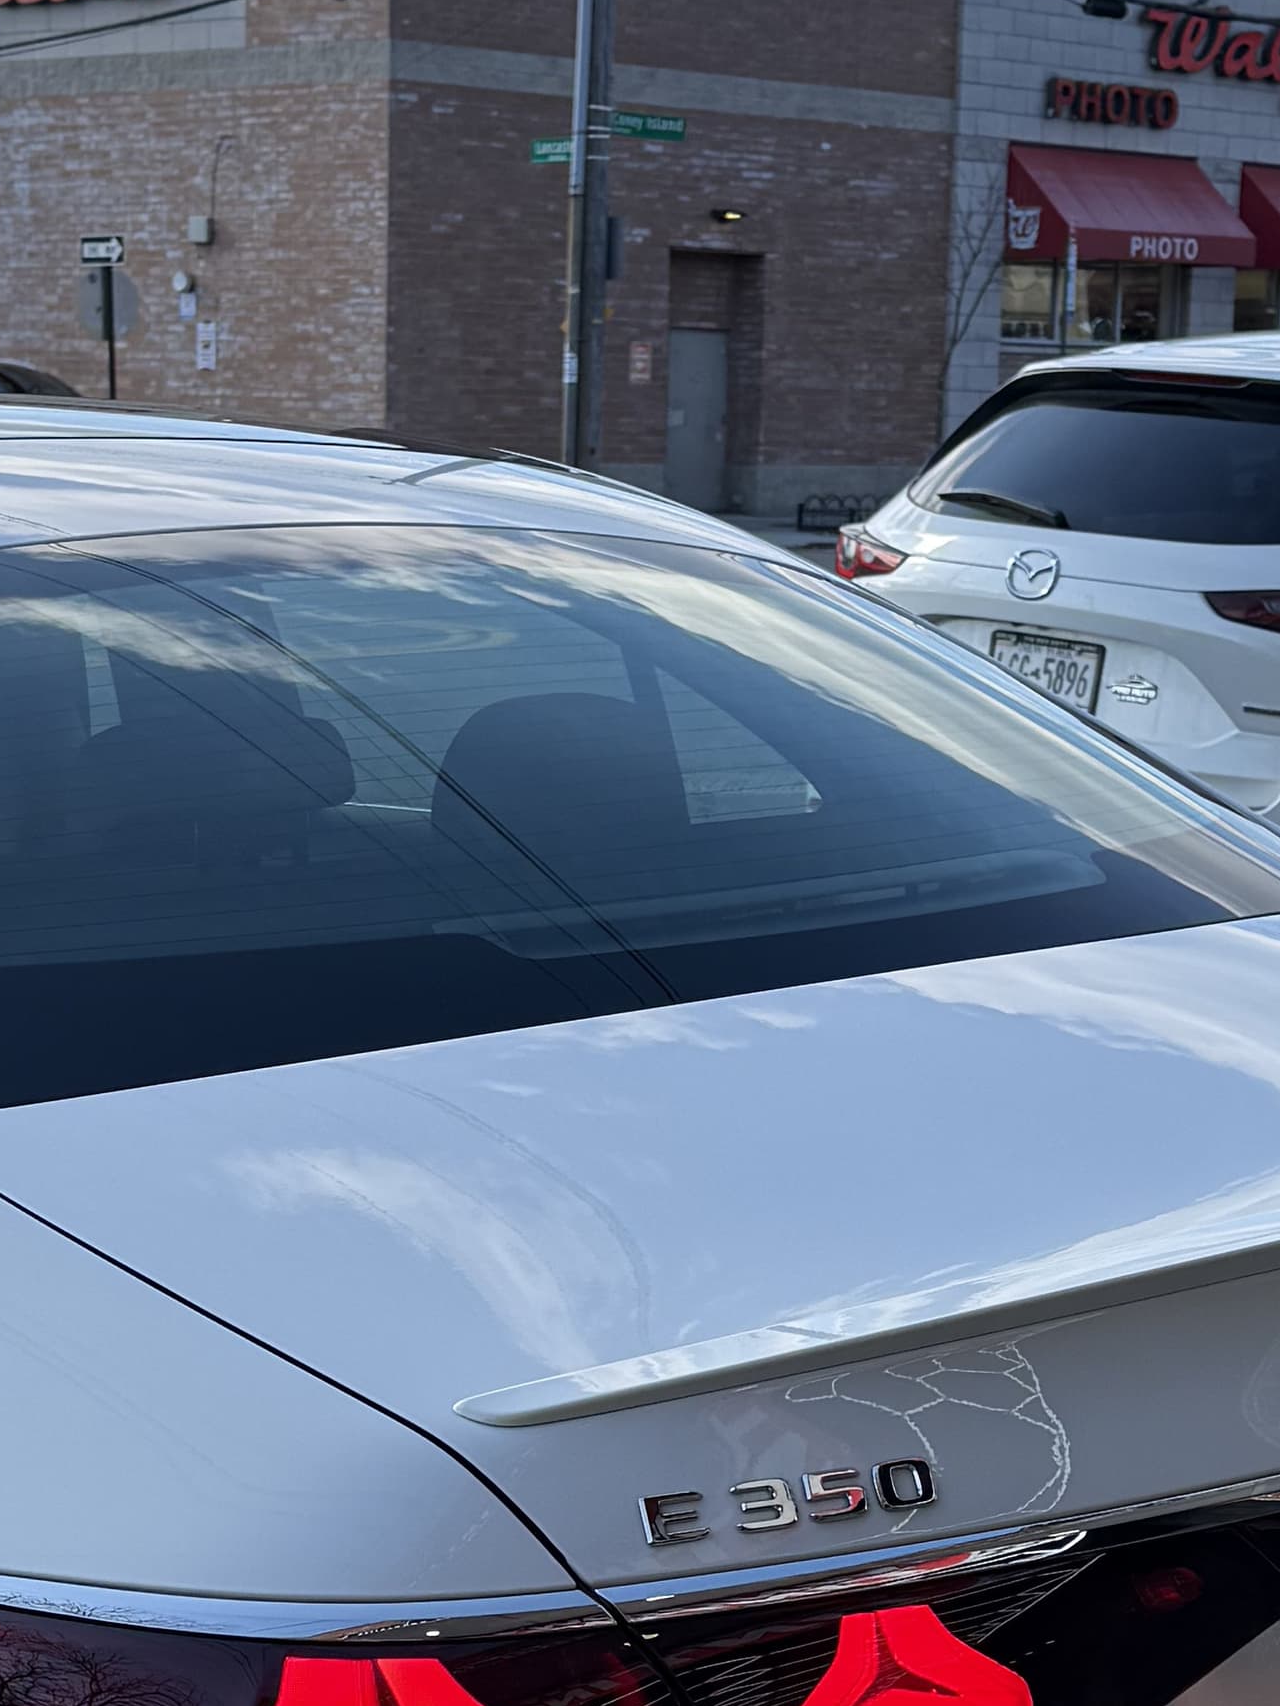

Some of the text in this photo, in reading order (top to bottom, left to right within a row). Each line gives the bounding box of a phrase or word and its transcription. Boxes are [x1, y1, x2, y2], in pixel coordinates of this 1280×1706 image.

[1050, 77, 1178, 130] PHOTO
[1130, 235, 1199, 261] PHOTO
[638, 1457, 939, 1546] E 350
